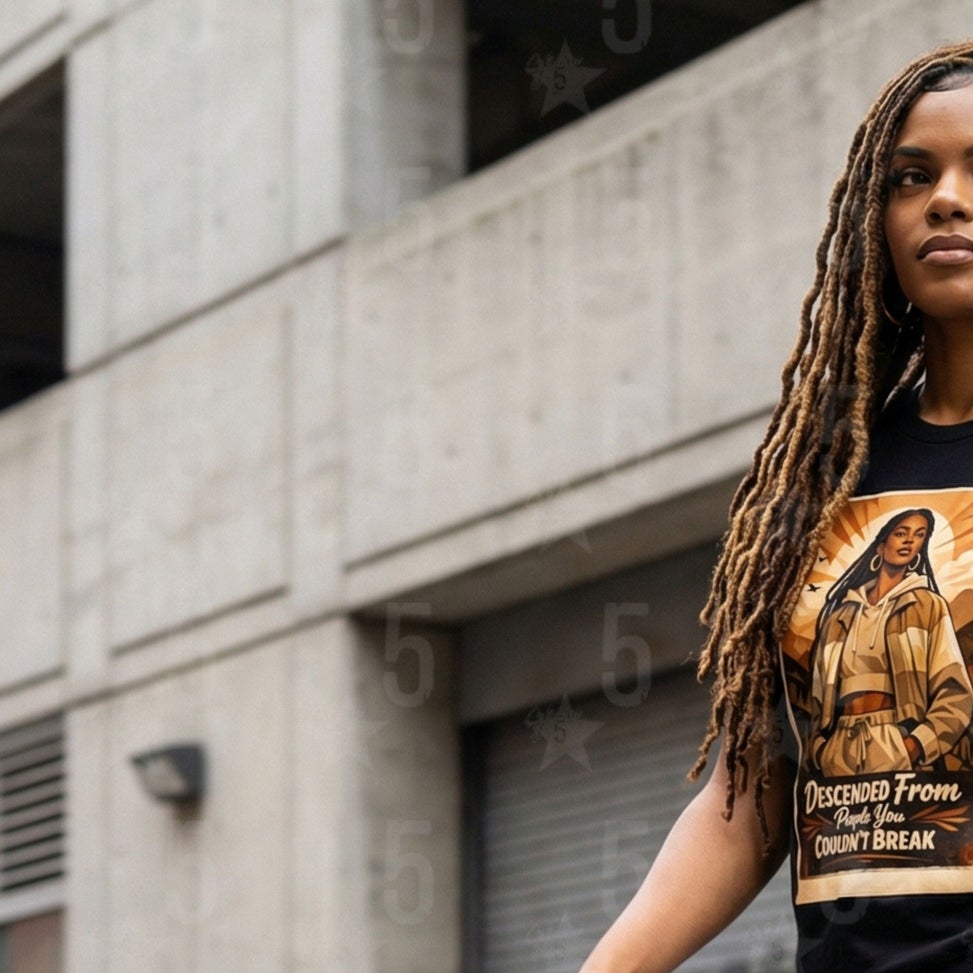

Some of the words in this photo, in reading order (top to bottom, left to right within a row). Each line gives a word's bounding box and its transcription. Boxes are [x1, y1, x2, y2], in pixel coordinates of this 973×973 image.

[804, 779, 890, 815] DESCENDED
[893, 772, 962, 806] From
[872, 803, 906, 828] You
[815, 829, 869, 859] COULDN'T
[872, 828, 936, 851] BREAK
